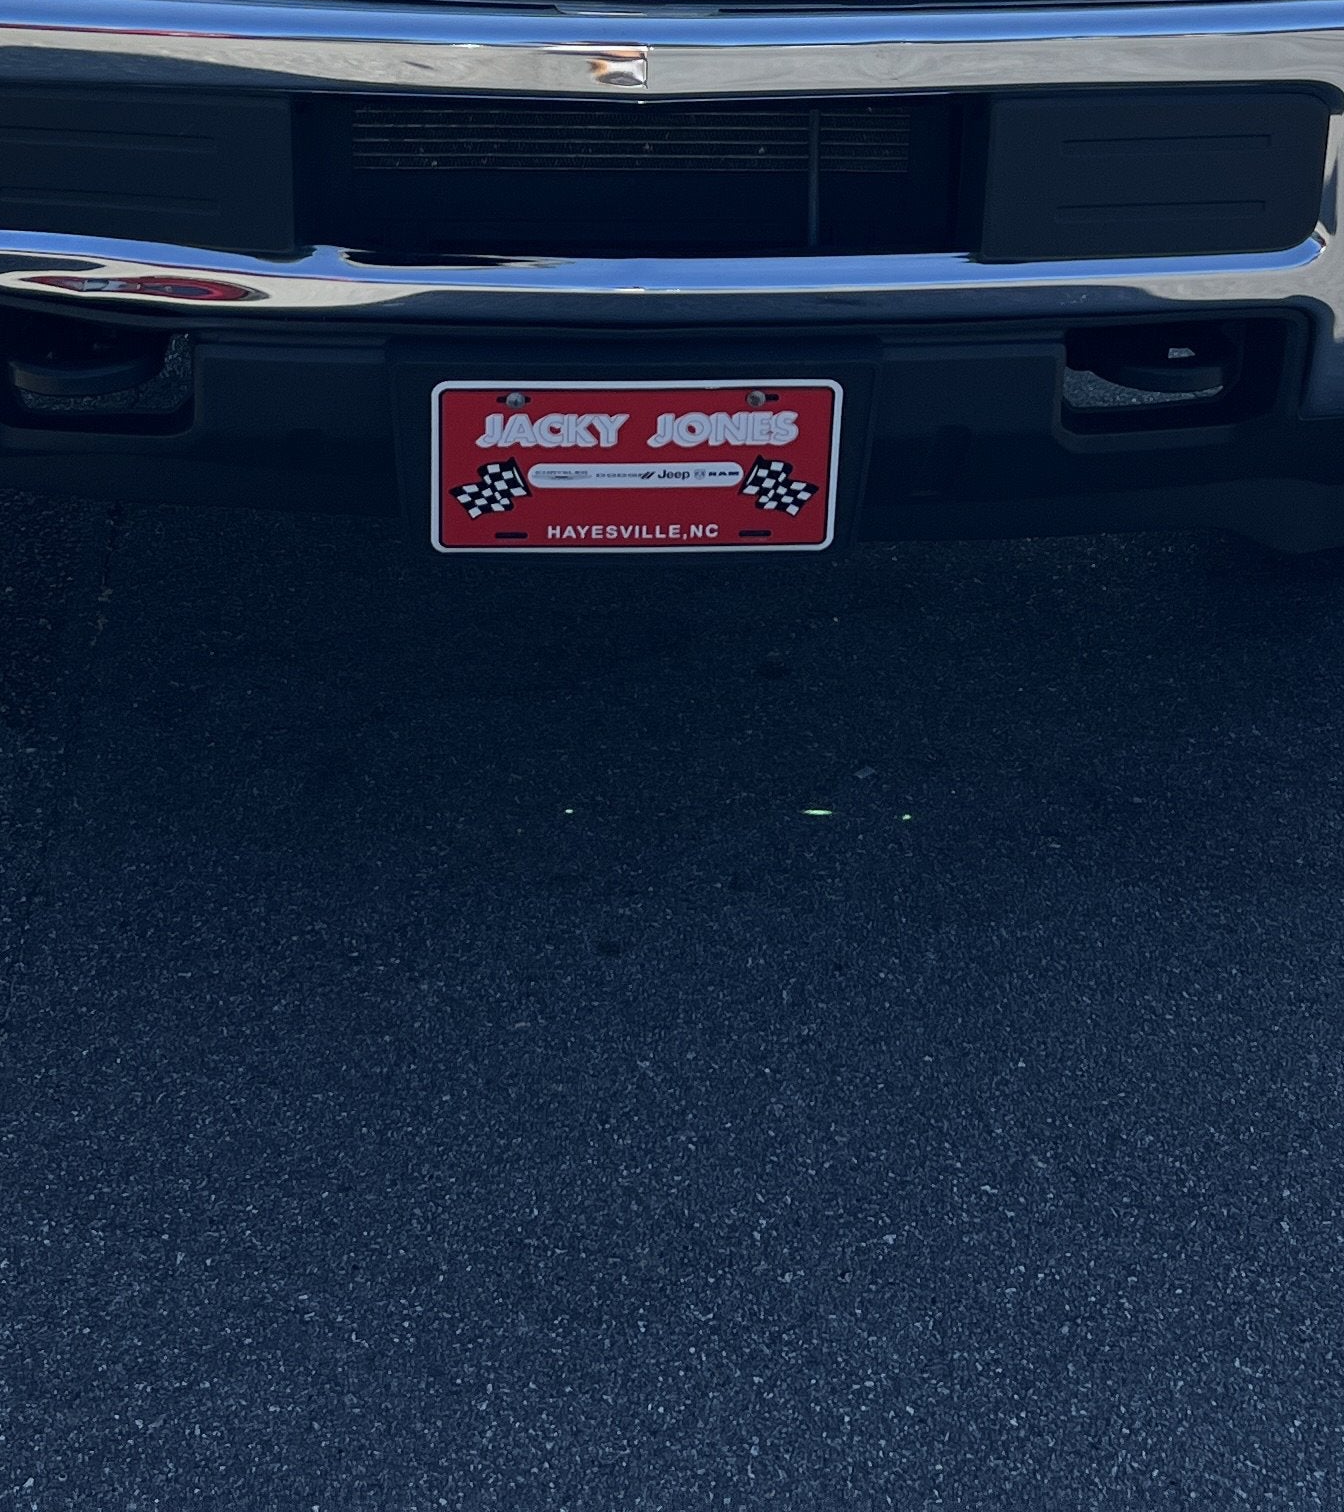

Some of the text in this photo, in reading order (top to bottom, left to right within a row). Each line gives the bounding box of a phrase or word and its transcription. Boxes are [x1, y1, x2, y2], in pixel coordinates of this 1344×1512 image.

[475, 411, 798, 448] JACKY JONES
[658, 469, 690, 480] Jeep
